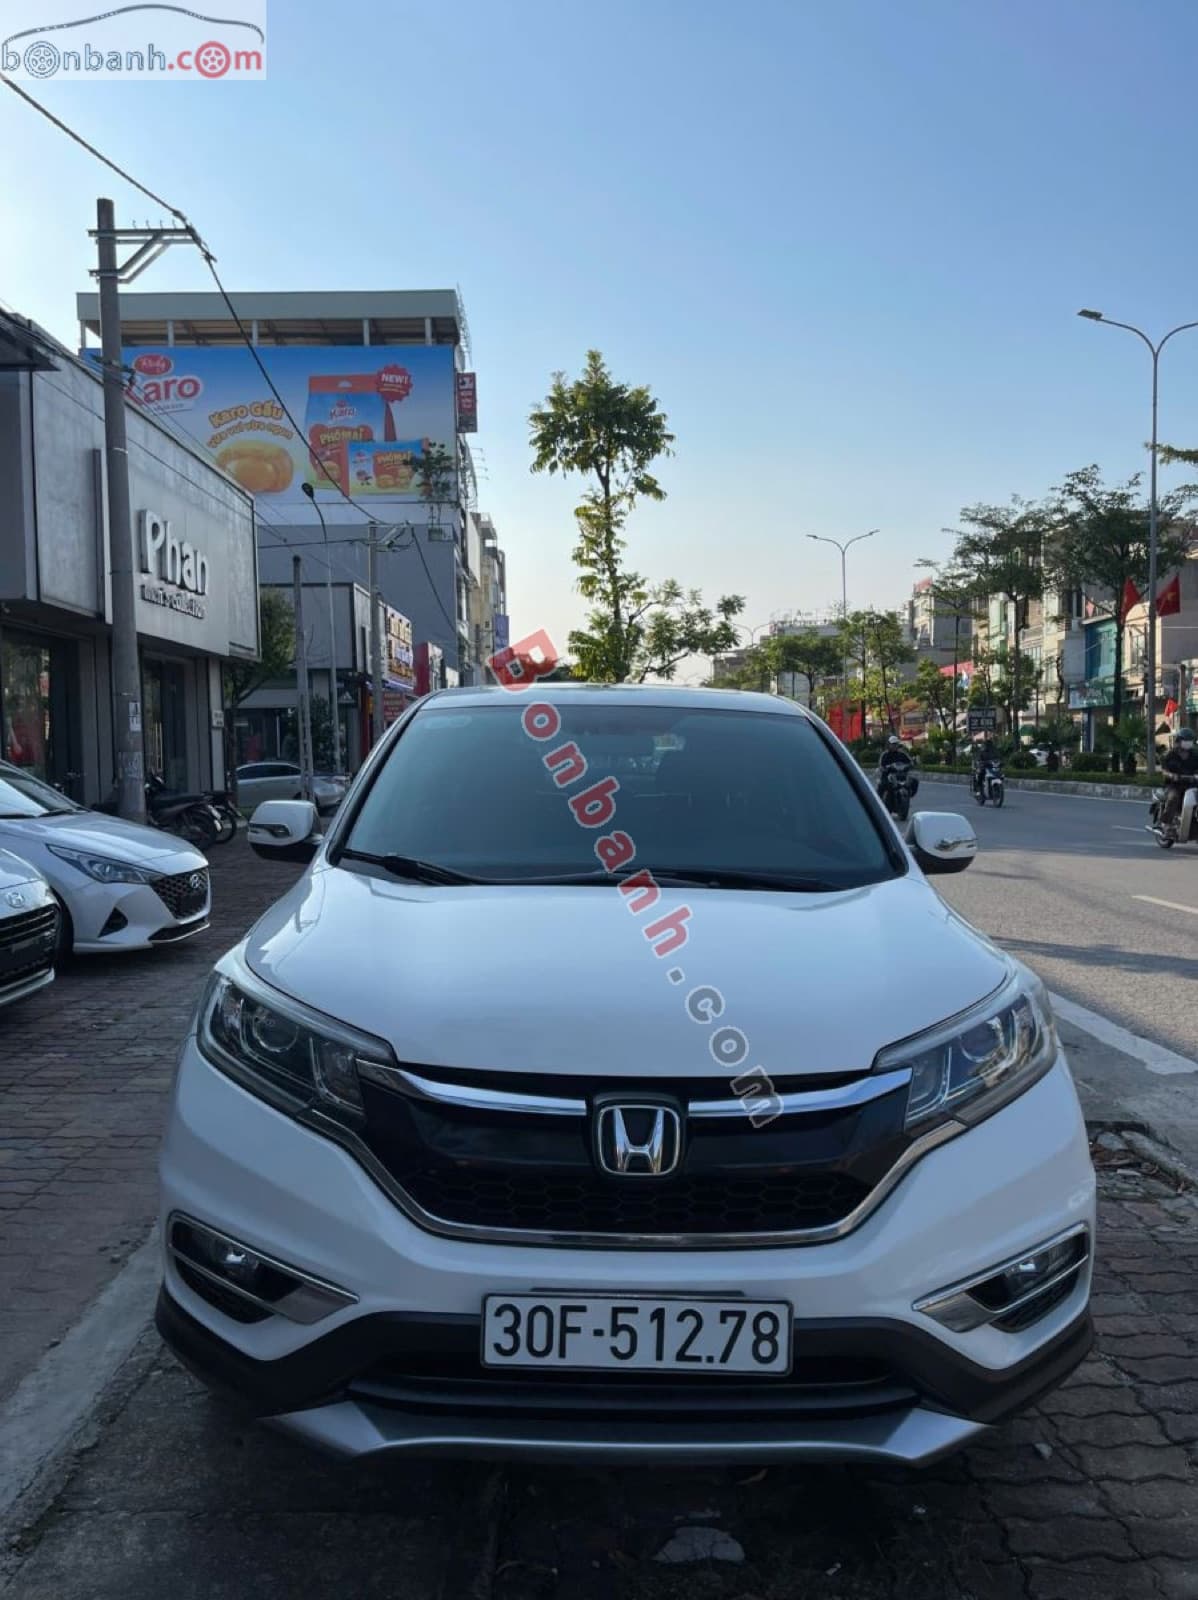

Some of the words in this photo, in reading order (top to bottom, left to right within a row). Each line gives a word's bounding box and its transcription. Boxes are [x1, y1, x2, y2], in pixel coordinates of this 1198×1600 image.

[208, 405, 247, 428] Karo
[138, 510, 208, 595] Phan
[493, 1303, 780, 1364] 30F-512.78
